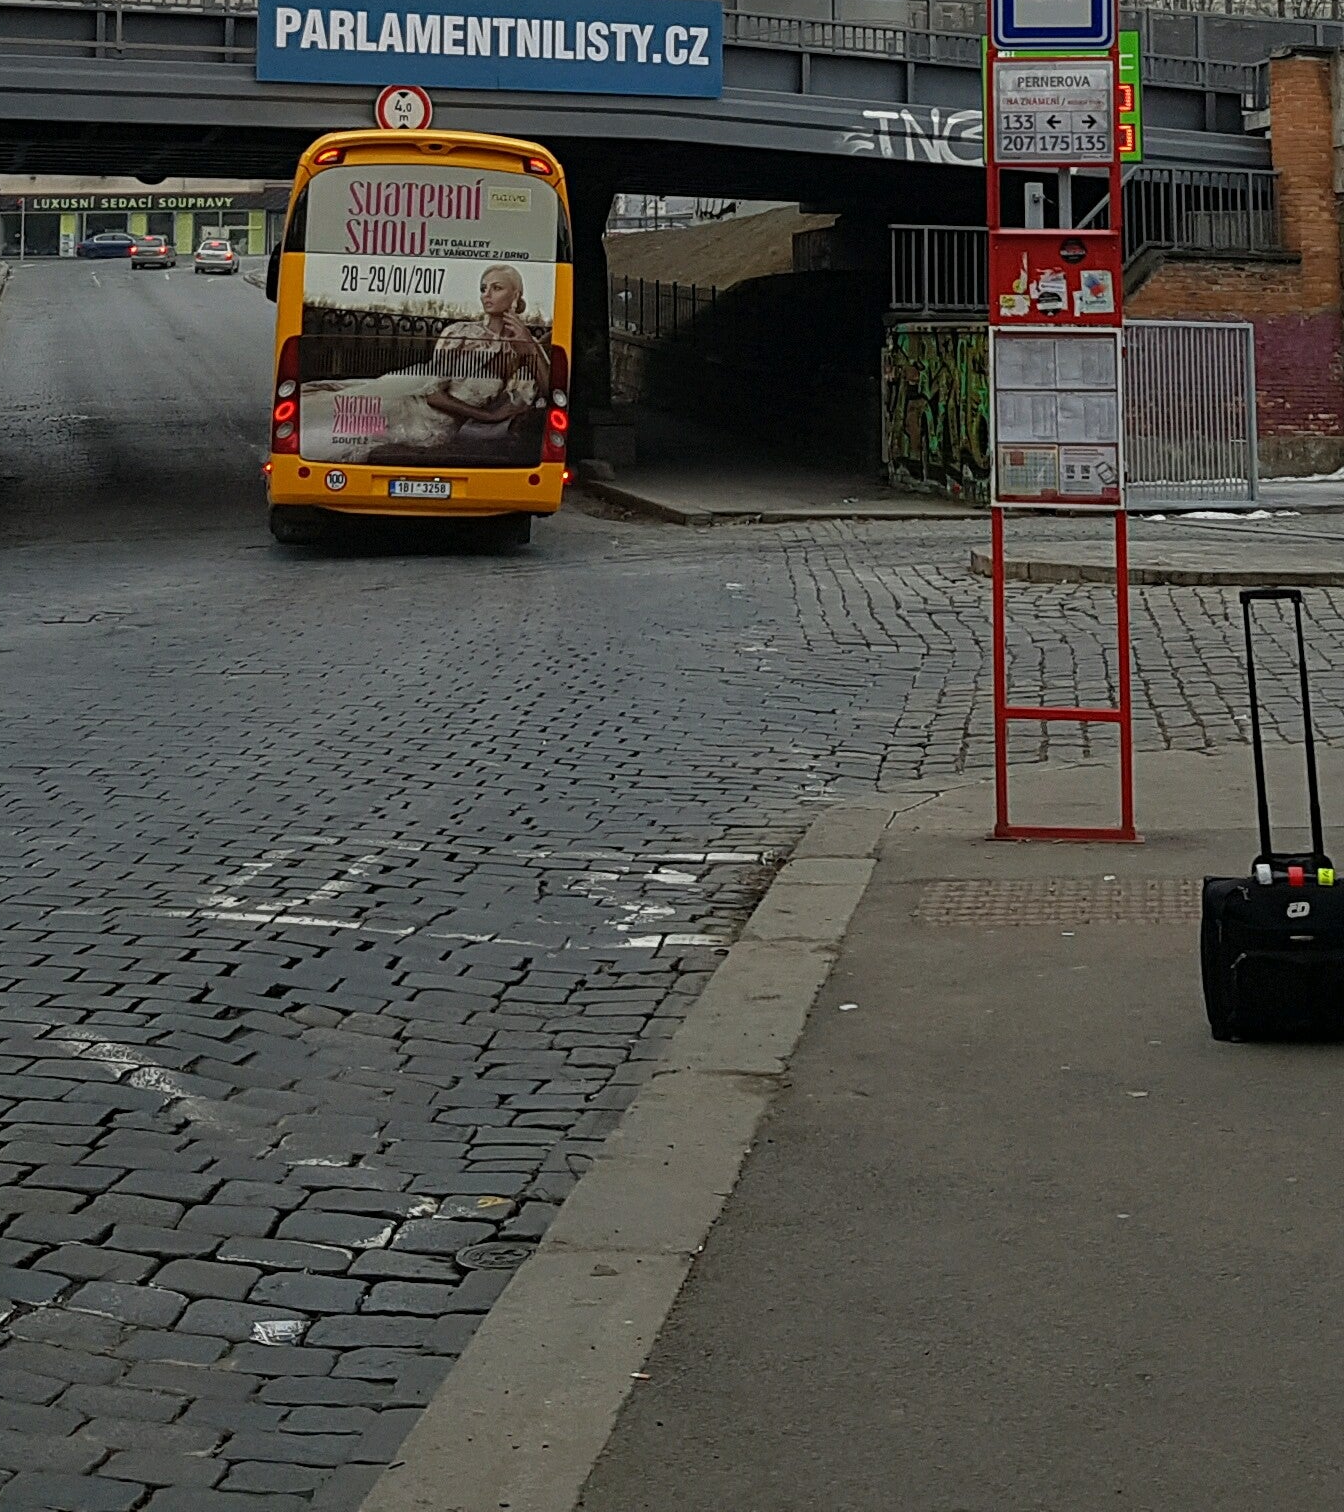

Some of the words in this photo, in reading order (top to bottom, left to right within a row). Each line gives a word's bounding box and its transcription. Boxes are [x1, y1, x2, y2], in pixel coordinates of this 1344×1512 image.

[275, 7, 710, 66] PARLAMENTNILISTY.CZ
[1017, 76, 1091, 88] PERNEROVA
[399, 114, 409, 122] m
[1003, 114, 1034, 131] 133
[1003, 135, 1035, 152] 207
[1040, 135, 1070, 152] 175
[1075, 135, 1106, 152] 135
[33, 195, 95, 209] LUXUSNÍ
[101, 194, 152, 208] SEDACÍ
[158, 197, 234, 208] SOUPRAVY
[344, 219, 427, 257] SHOW
[429, 238, 449, 247] FAIT
[451, 239, 491, 248] GALLERY
[429, 248, 441, 256] VE
[328, 473, 344, 484] 100
